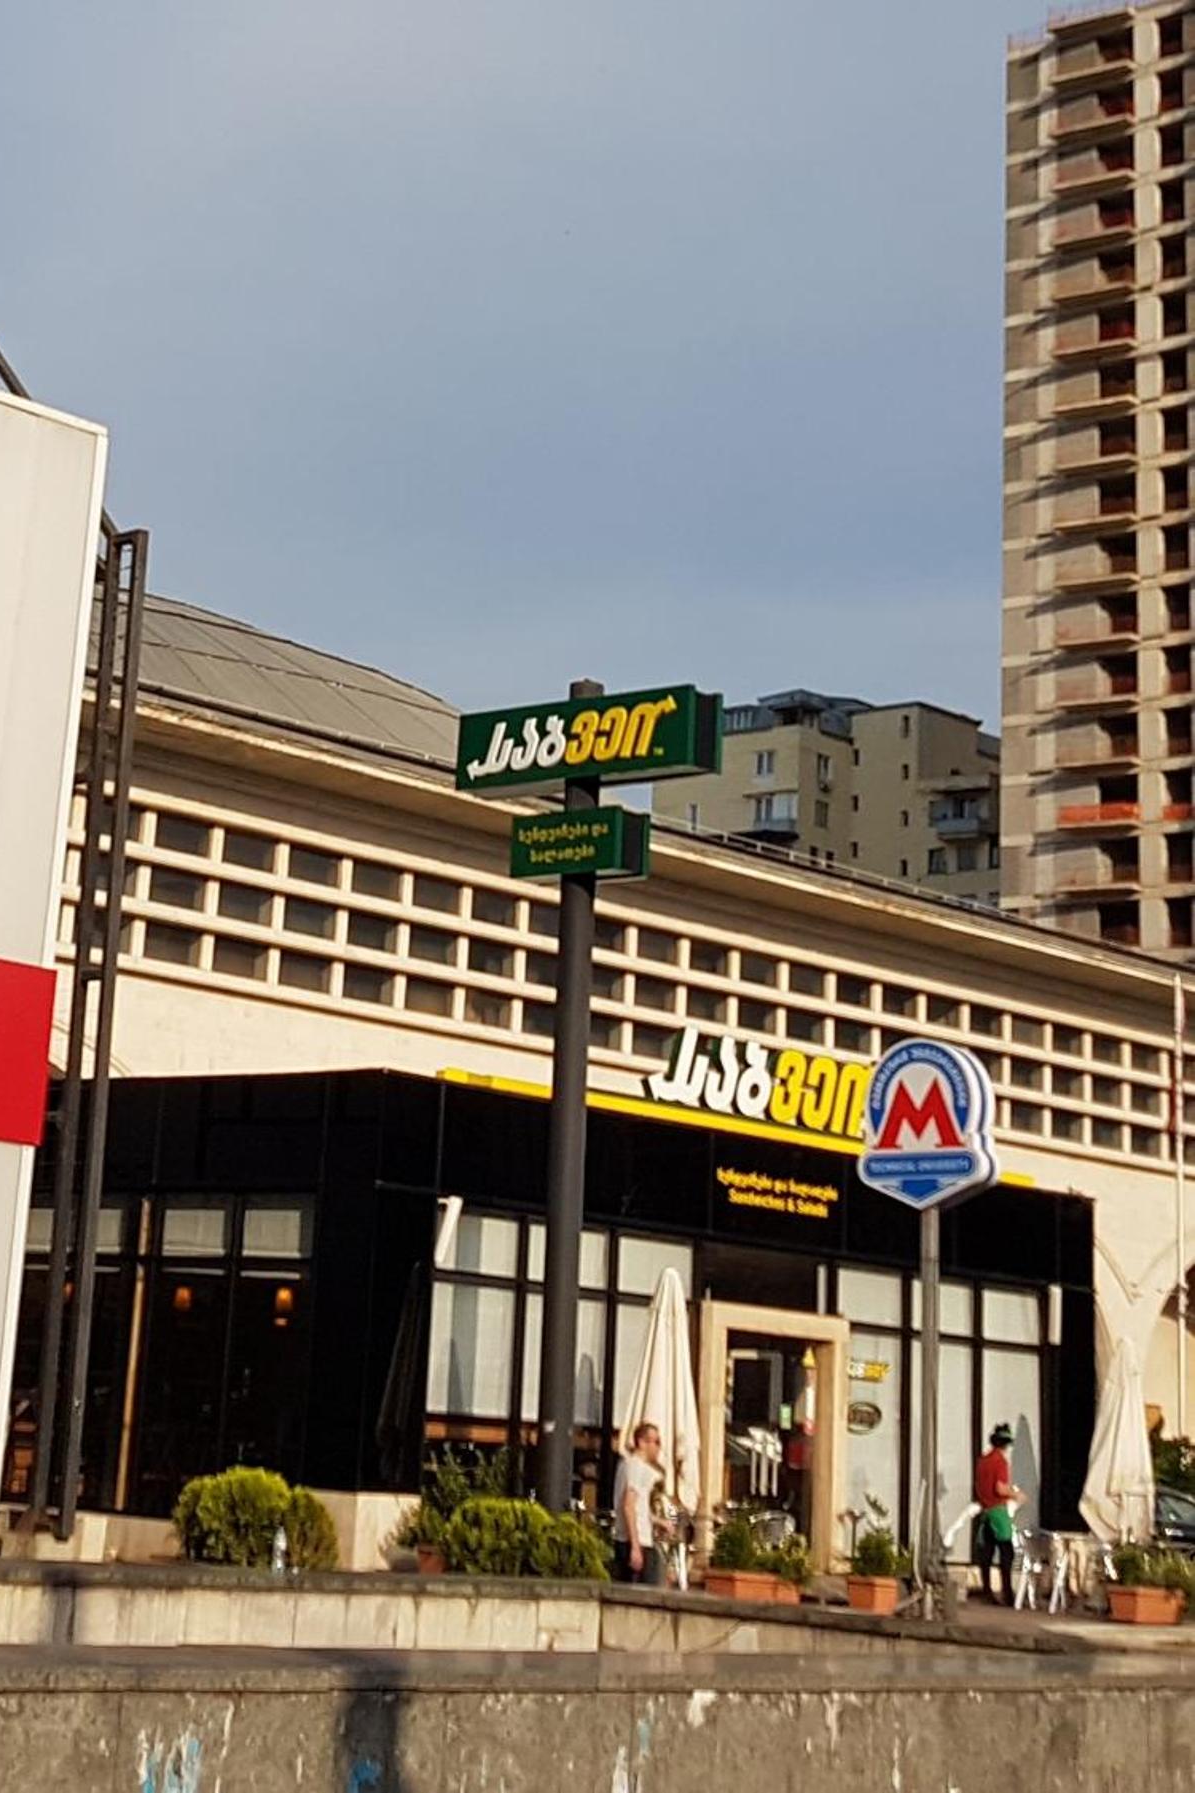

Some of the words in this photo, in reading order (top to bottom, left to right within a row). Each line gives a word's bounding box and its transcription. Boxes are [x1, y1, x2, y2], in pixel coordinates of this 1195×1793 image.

[466, 694, 677, 782] საბვეი
[591, 822, 609, 838] და
[872, 1076, 967, 1151] M
